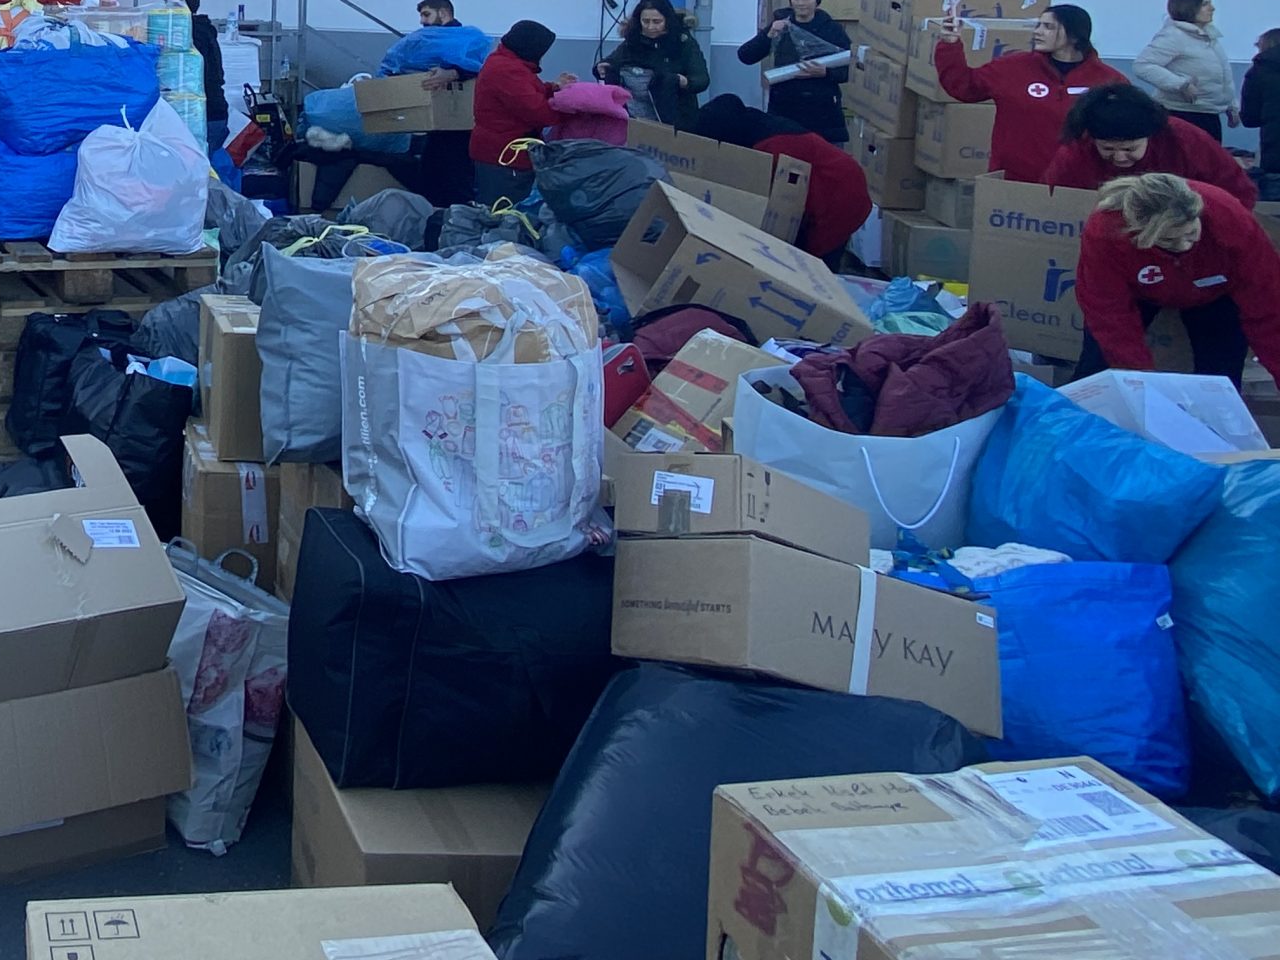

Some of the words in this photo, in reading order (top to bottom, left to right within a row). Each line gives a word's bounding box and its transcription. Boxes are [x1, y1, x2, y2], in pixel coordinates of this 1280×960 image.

[700, 602, 732, 614] STARTS
[811, 611, 892, 659] MAY
[902, 637, 953, 676] KAY
[855, 872, 982, 905] orthomol
